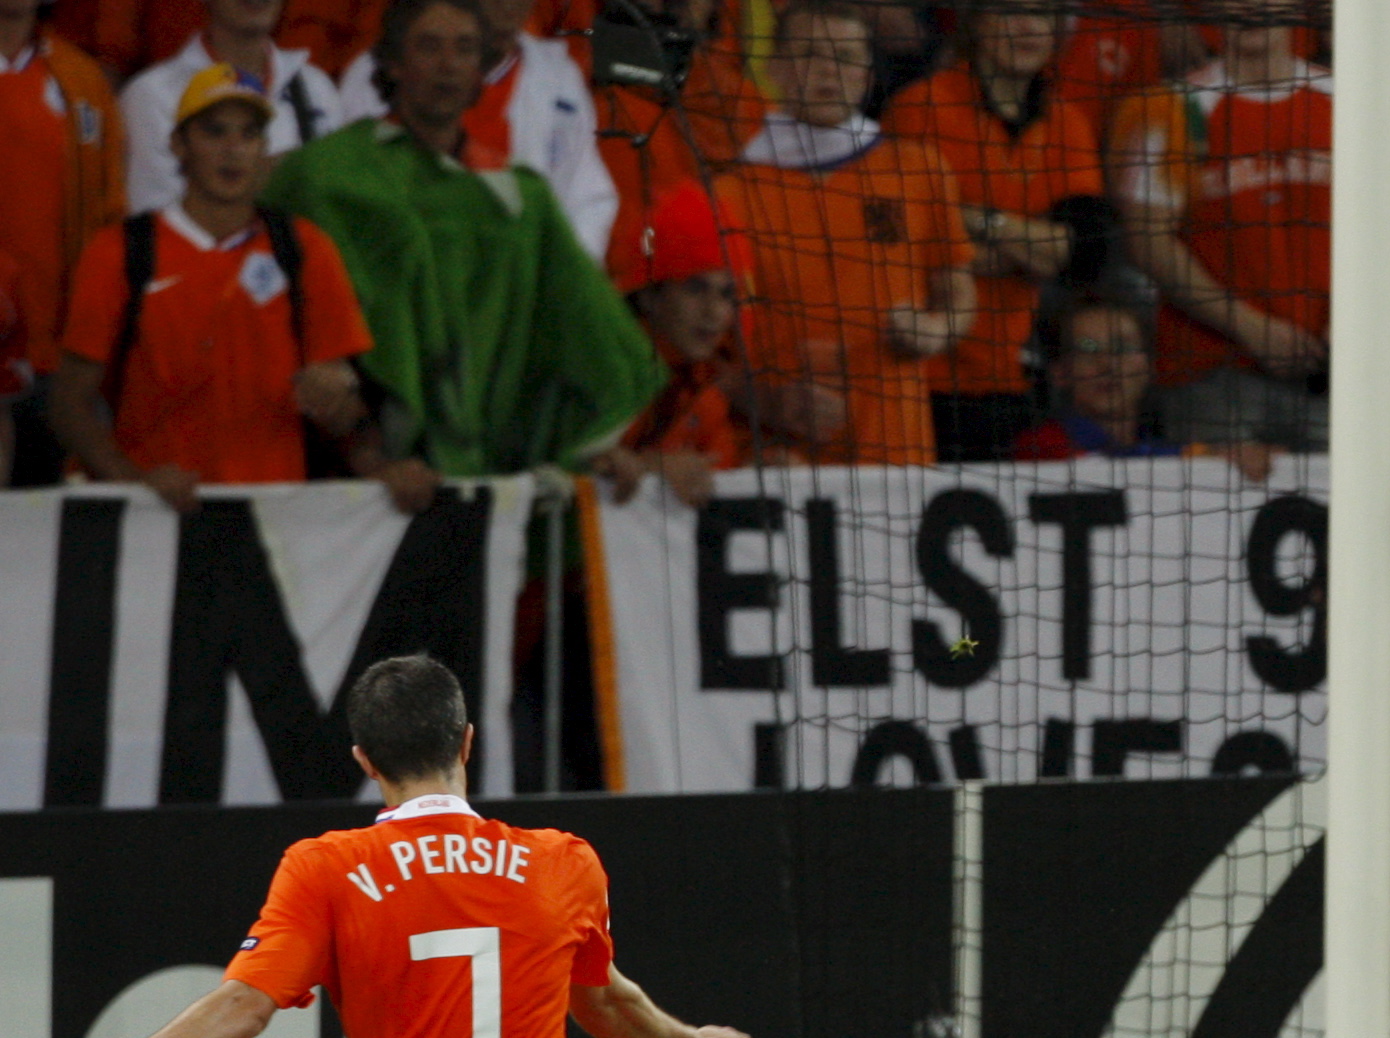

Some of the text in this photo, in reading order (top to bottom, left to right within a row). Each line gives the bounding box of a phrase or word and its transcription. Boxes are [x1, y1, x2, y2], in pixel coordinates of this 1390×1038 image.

[697, 488, 1128, 692] ELST
[346, 834, 531, 902] V. PERSIE
